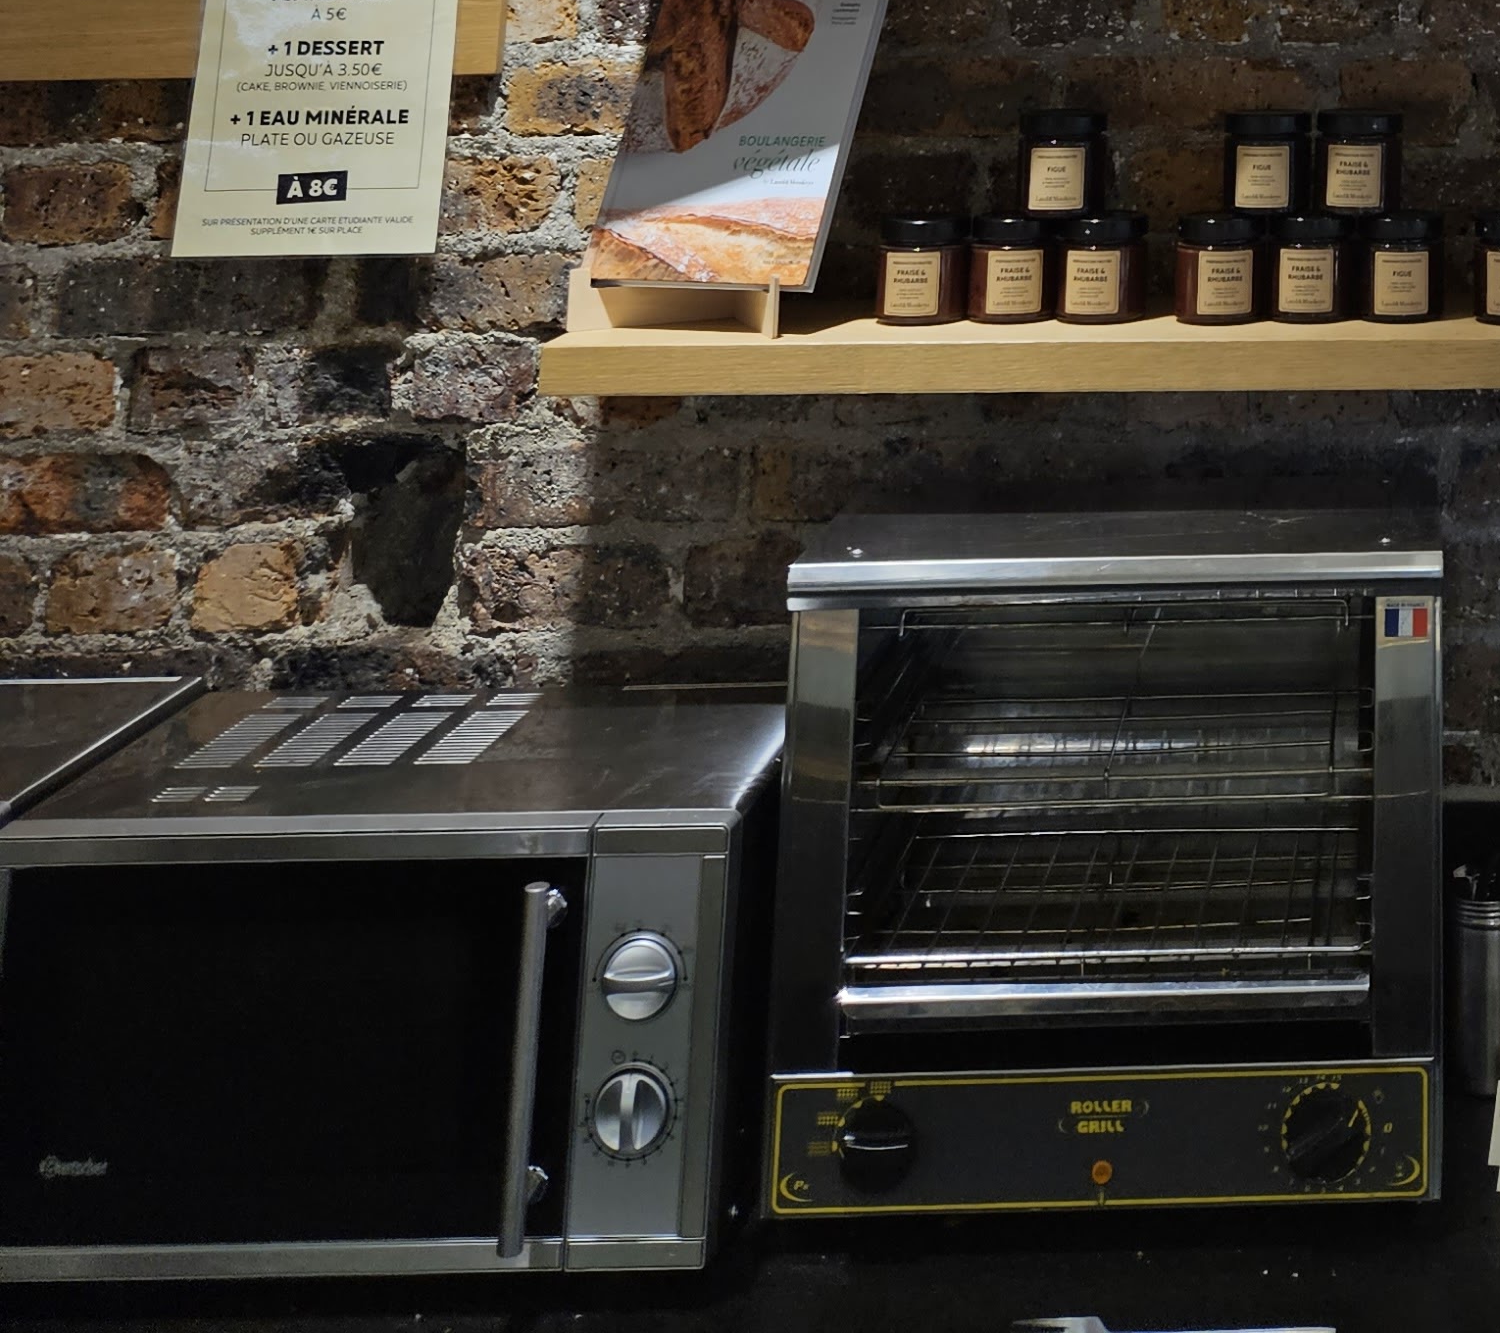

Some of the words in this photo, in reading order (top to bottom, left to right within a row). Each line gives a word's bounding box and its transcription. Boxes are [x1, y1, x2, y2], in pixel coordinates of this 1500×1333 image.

[311, 4, 321, 20] À
[326, 7, 347, 21] 5€
[267, 44, 279, 55] +
[284, 40, 292, 56] 1
[297, 40, 385, 56] DESSERT
[264, 62, 334, 79] JUSQU'À
[236, 81, 272, 93] (CAKE,
[329, 80, 408, 92] VIENNOISERIE)
[230, 114, 241, 125] +
[246, 110, 255, 126] 1
[259, 110, 300, 126] EAU
[305, 105, 410, 126] MINÉRALE
[240, 132, 290, 147] PLATE
[293, 132, 318, 146] OU
[321, 131, 395, 146] GAZEUSE
[738, 135, 826, 148] BOULANGERIE
[733, 149, 821, 179] végétale
[1046, 165, 1067, 173] FIGUE
[286, 175, 304, 199] À
[308, 178, 338, 197] 8€
[201, 218, 219, 227] SUR
[219, 217, 282, 226] PRÉSENTATION
[282, 216, 309, 225] D'UNE
[309, 216, 337, 225] CARTE
[337, 215, 383, 225] ETUDIANTE
[384, 215, 414, 224] VALIDE
[318, 226, 336, 235] SUR
[336, 225, 363, 235] PLACE
[1070, 1099, 1132, 1115] ROLLER
[1076, 1119, 1125, 1134] GRILL
